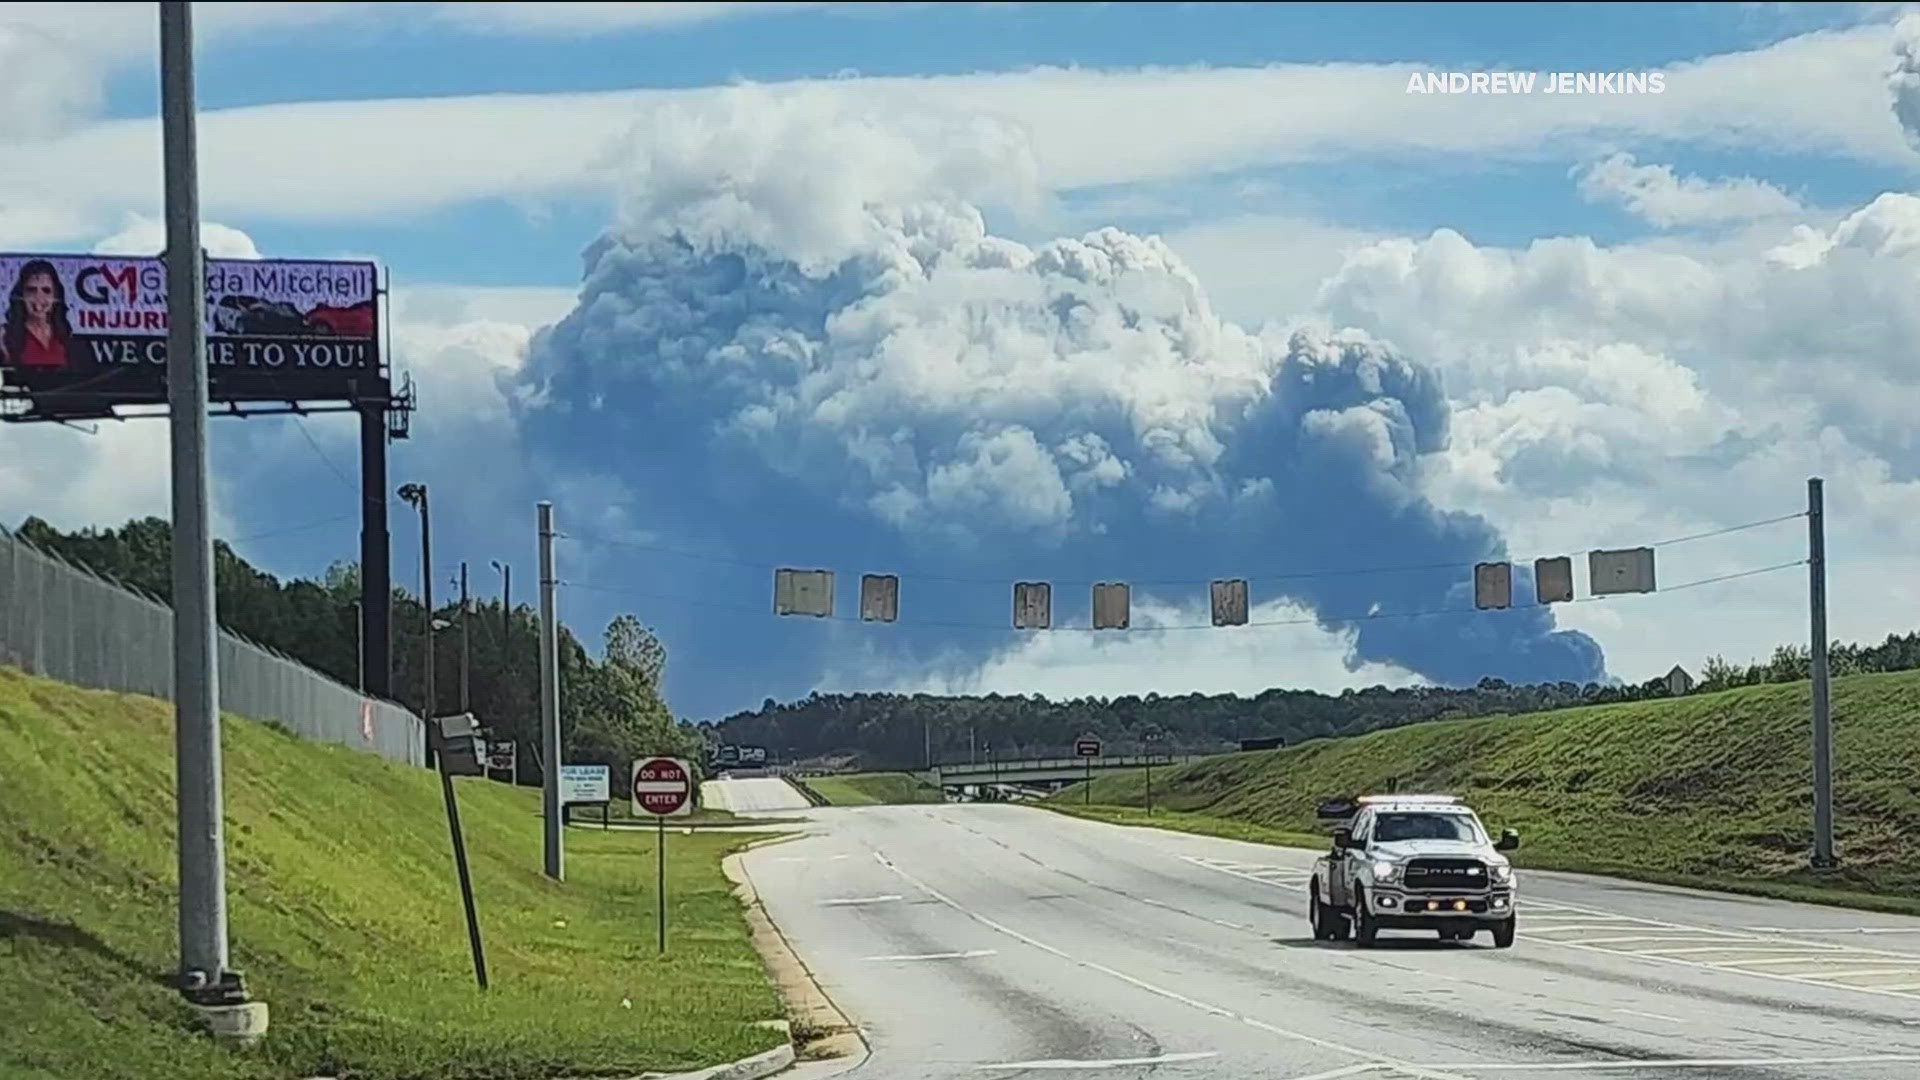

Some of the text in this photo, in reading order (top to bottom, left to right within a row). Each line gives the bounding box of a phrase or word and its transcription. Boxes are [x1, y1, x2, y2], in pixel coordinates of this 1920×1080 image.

[254, 267, 366, 295] Mitchell
[91, 340, 139, 364] WE
[243, 342, 286, 366] TO
[292, 343, 366, 368] YOU!
[640, 769, 681, 780] DO NOT
[644, 794, 678, 806] ENTER
